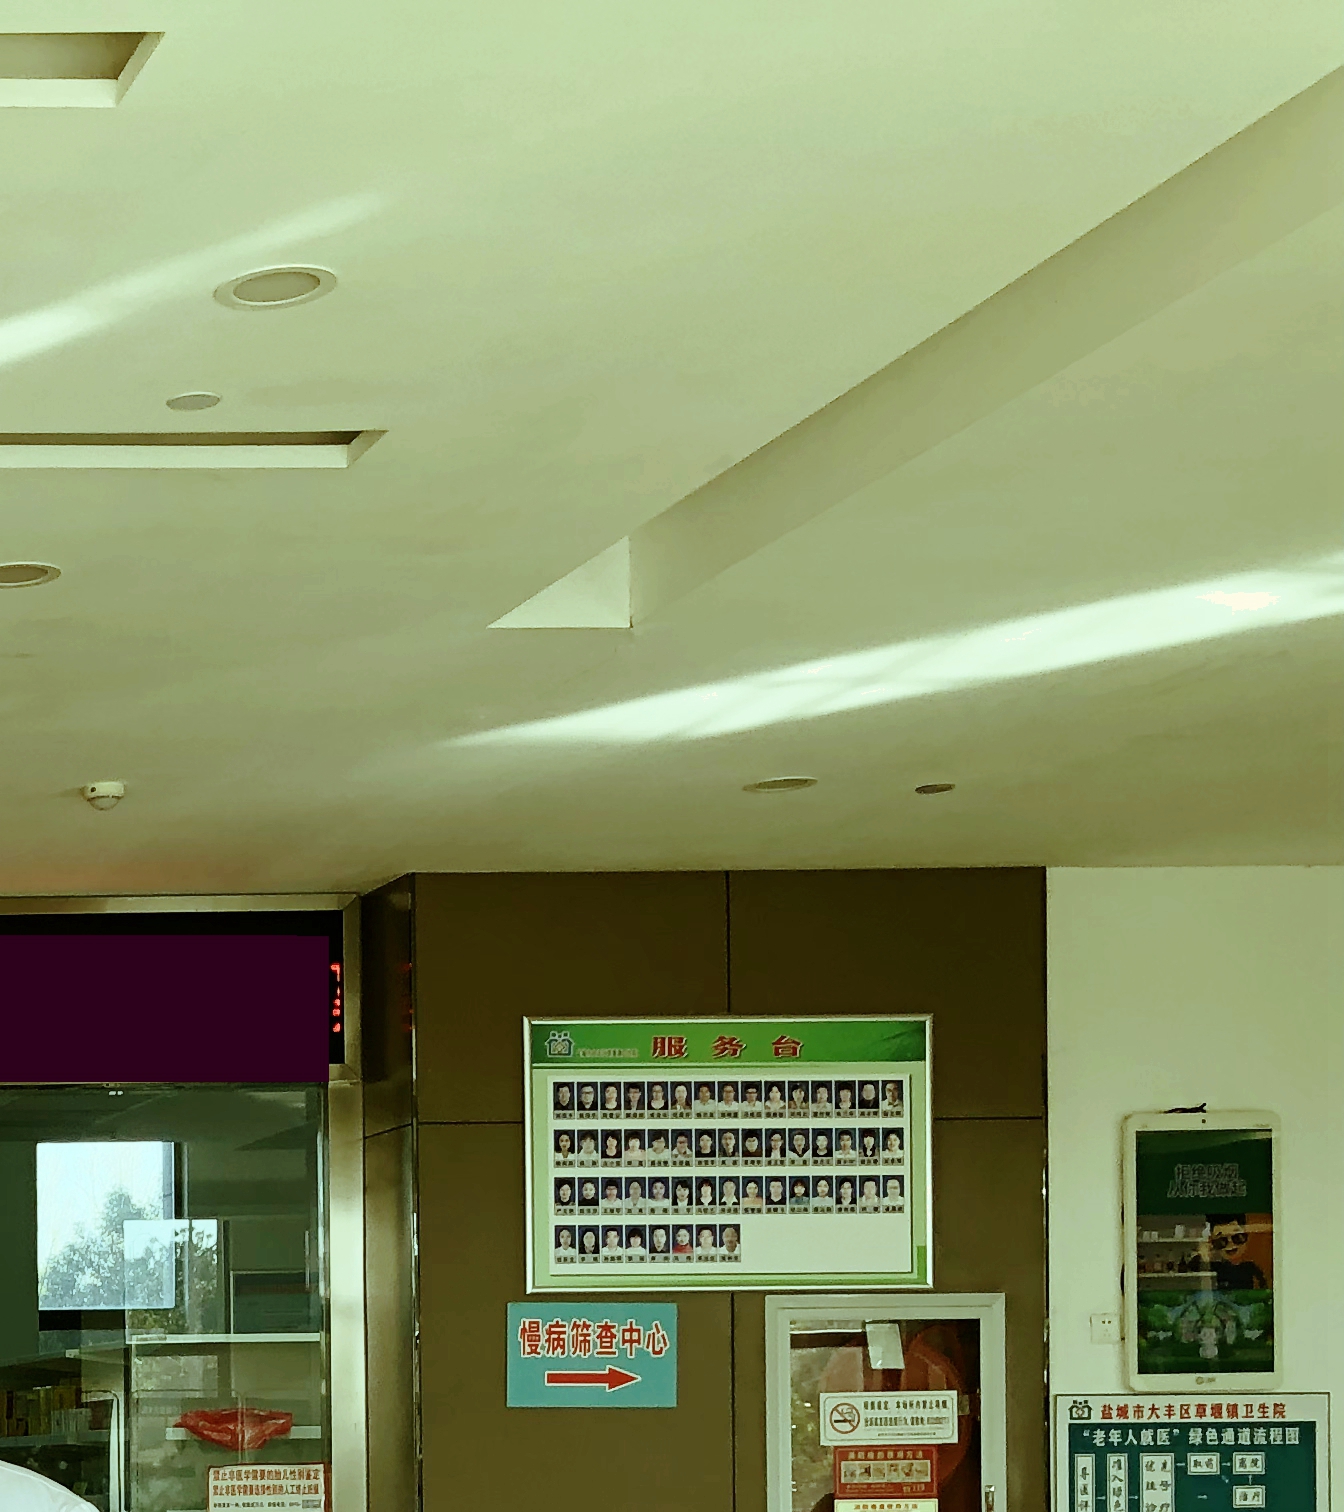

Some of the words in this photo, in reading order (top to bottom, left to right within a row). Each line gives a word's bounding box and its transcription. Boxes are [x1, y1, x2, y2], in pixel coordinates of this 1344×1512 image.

[652, 1034, 804, 1059] 服务台
[1174, 1163, 1240, 1180] 拒绝吸烟
[518, 1318, 669, 1358] 慢病筛查中心
[1100, 1402, 1287, 1420] 盐城市大丰区草堰镇卫生院
[1188, 1427, 1301, 1446] 绿色通道流程图
